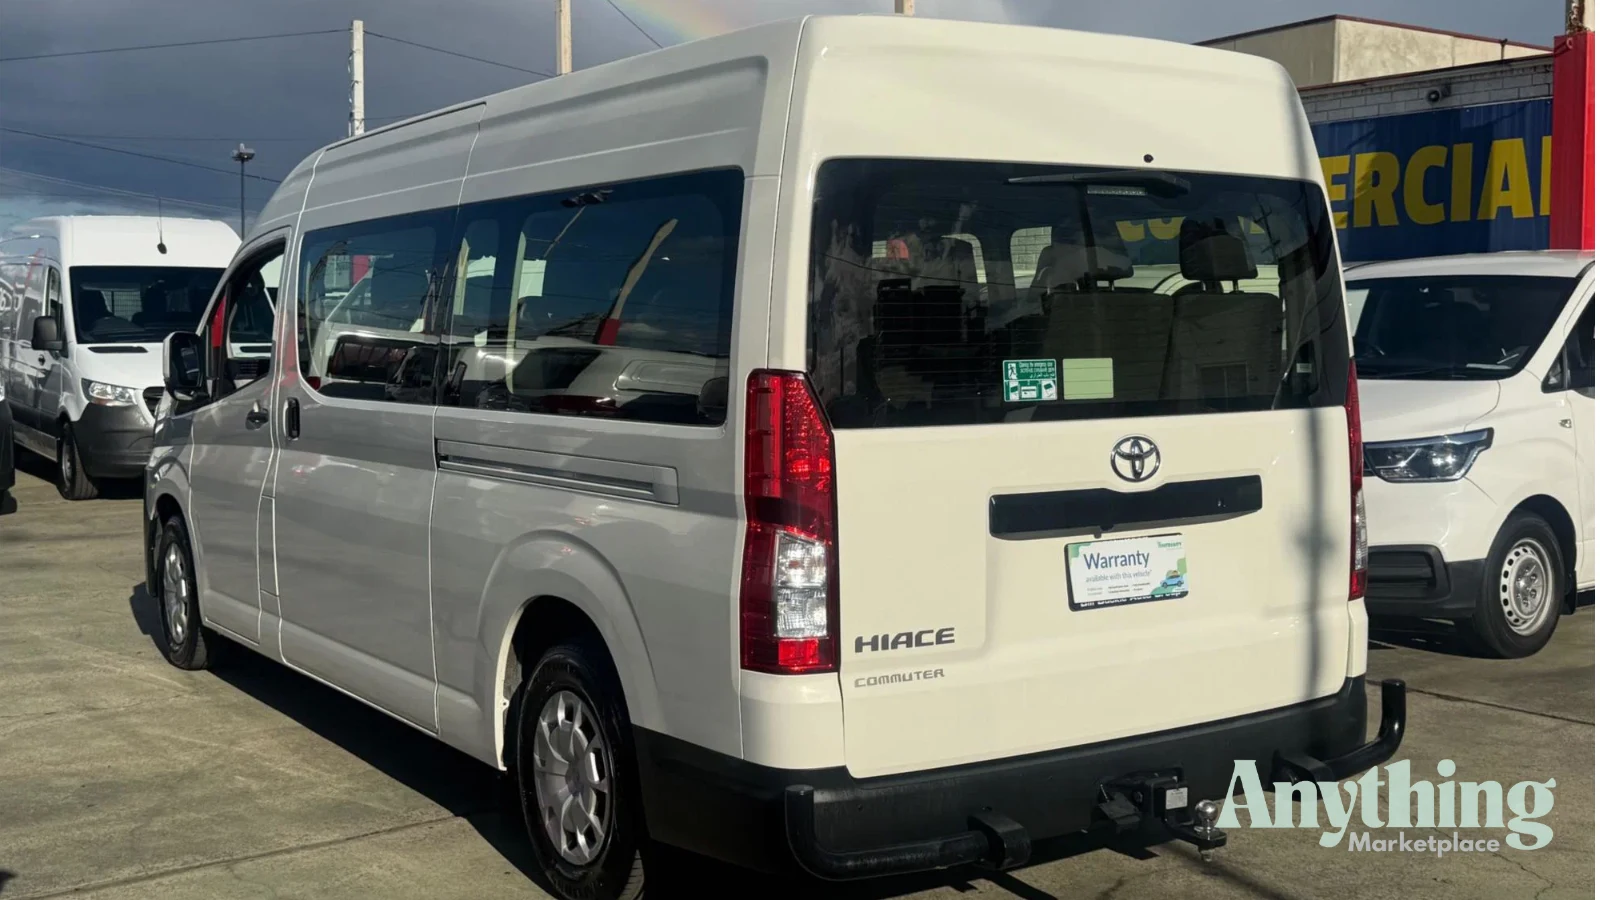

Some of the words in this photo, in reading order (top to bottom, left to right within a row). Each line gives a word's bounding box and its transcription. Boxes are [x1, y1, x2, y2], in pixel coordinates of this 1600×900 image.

[1083, 550, 1150, 570] Warranty
[1085, 573, 1109, 583] available
[1109, 572, 1121, 580] with
[1122, 570, 1132, 579] this
[854, 626, 956, 654] HIACE
[854, 668, 946, 688] COMMUTER
